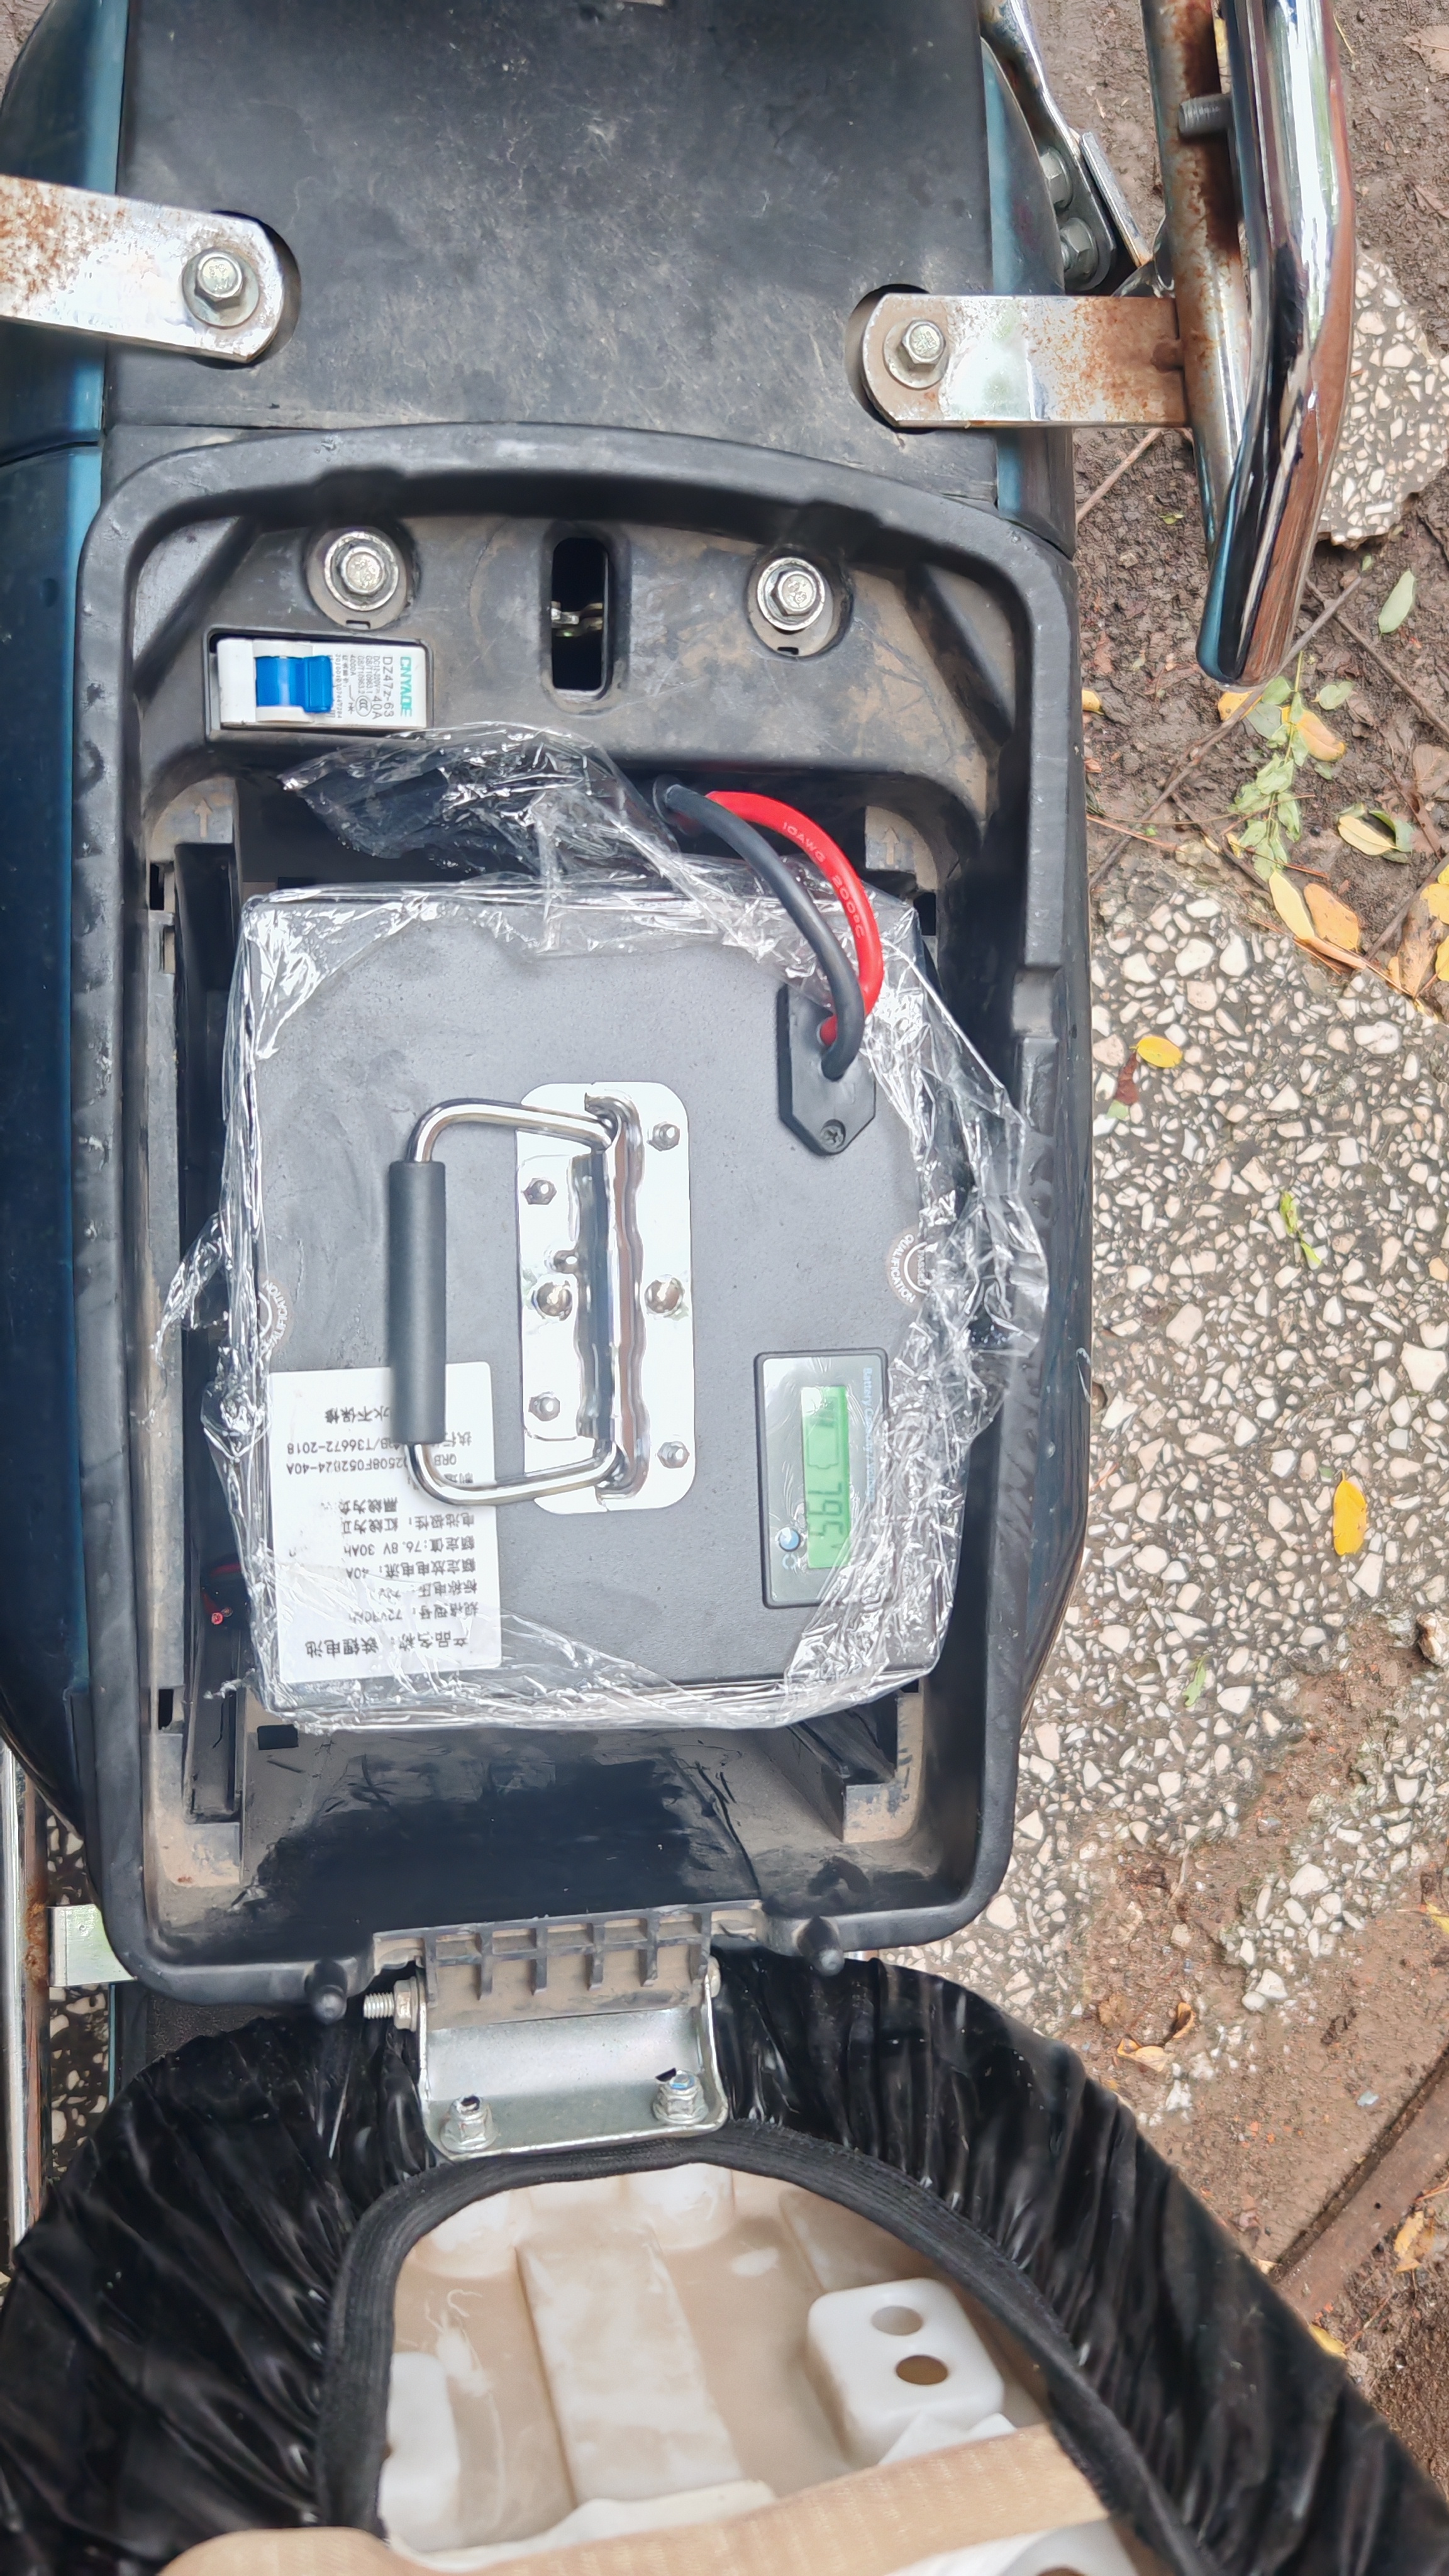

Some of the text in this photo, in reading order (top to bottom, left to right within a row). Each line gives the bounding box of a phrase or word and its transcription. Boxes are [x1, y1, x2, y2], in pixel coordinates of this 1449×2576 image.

[372, 696, 382, 719] 40A
[782, 821, 826, 863] 10AWG
[891, 1234, 916, 1304] QUALIFICATION
[325, 1406, 390, 1423] 水不保修
[343, 1543, 374, 1557] 30Ah
